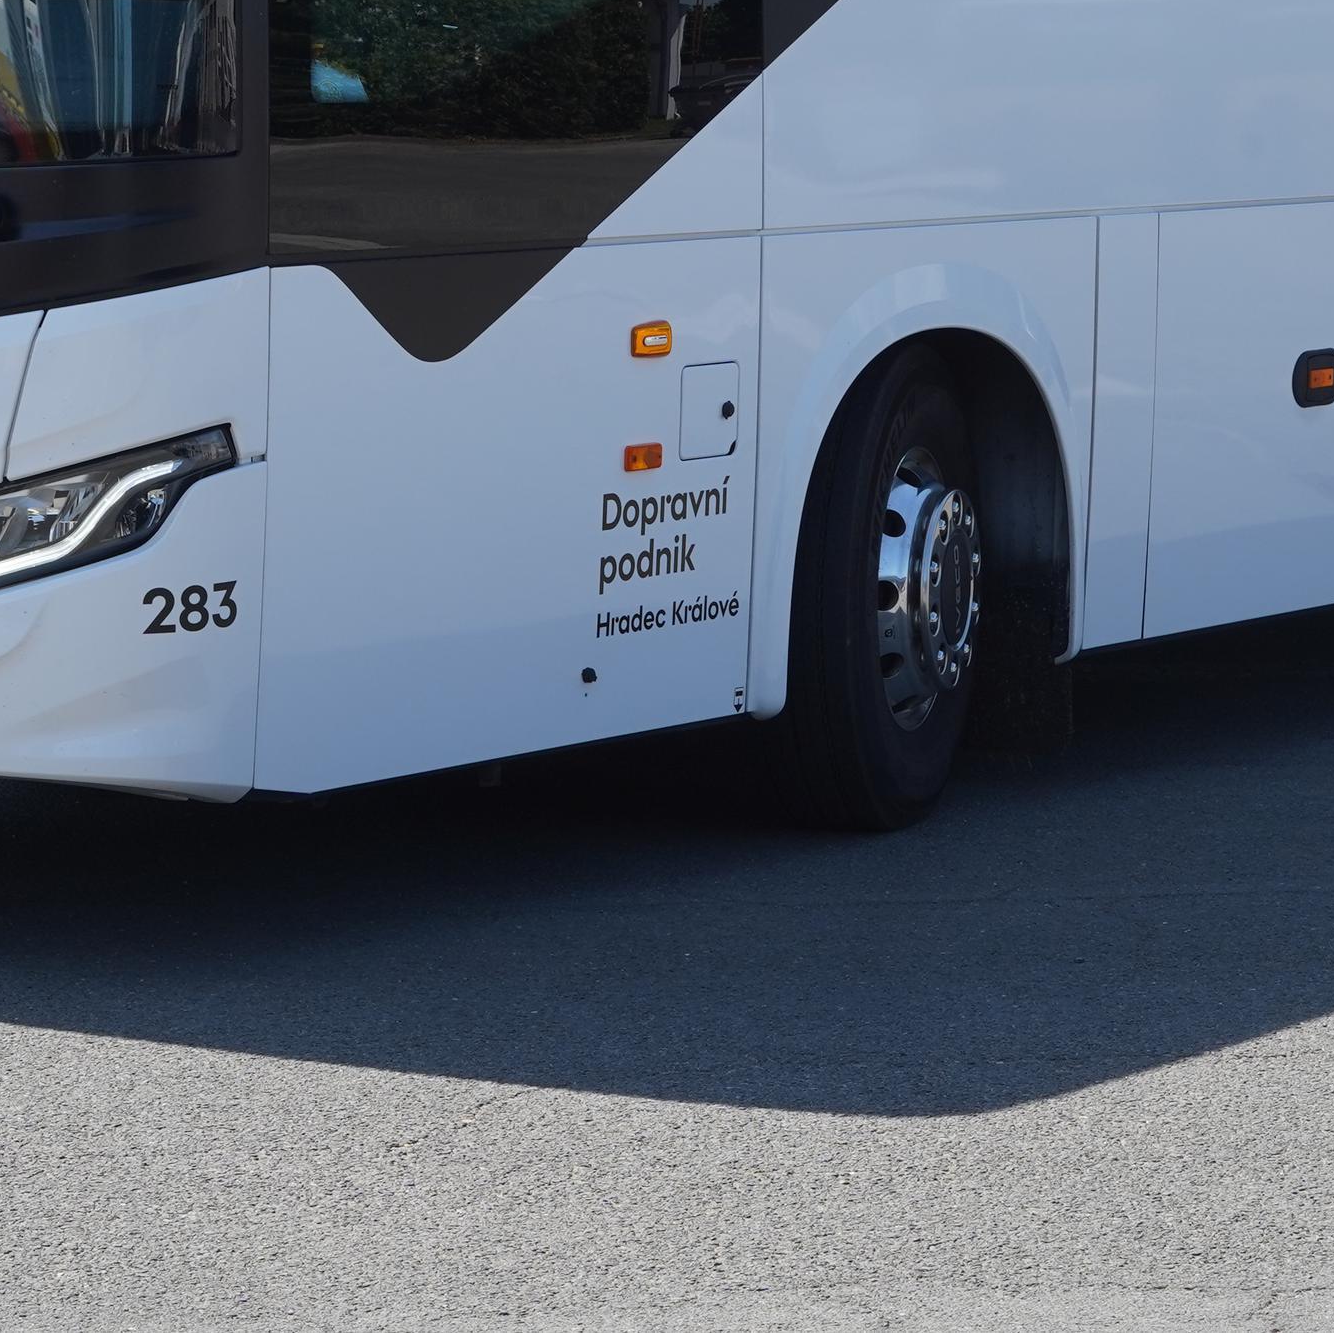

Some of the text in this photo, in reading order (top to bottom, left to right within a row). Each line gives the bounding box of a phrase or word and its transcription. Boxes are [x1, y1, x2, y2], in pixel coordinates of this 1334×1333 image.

[602, 475, 730, 535] Dopravní
[599, 534, 695, 595] podnik
[142, 580, 238, 634] 283
[596, 591, 740, 638] Hradec Králové
